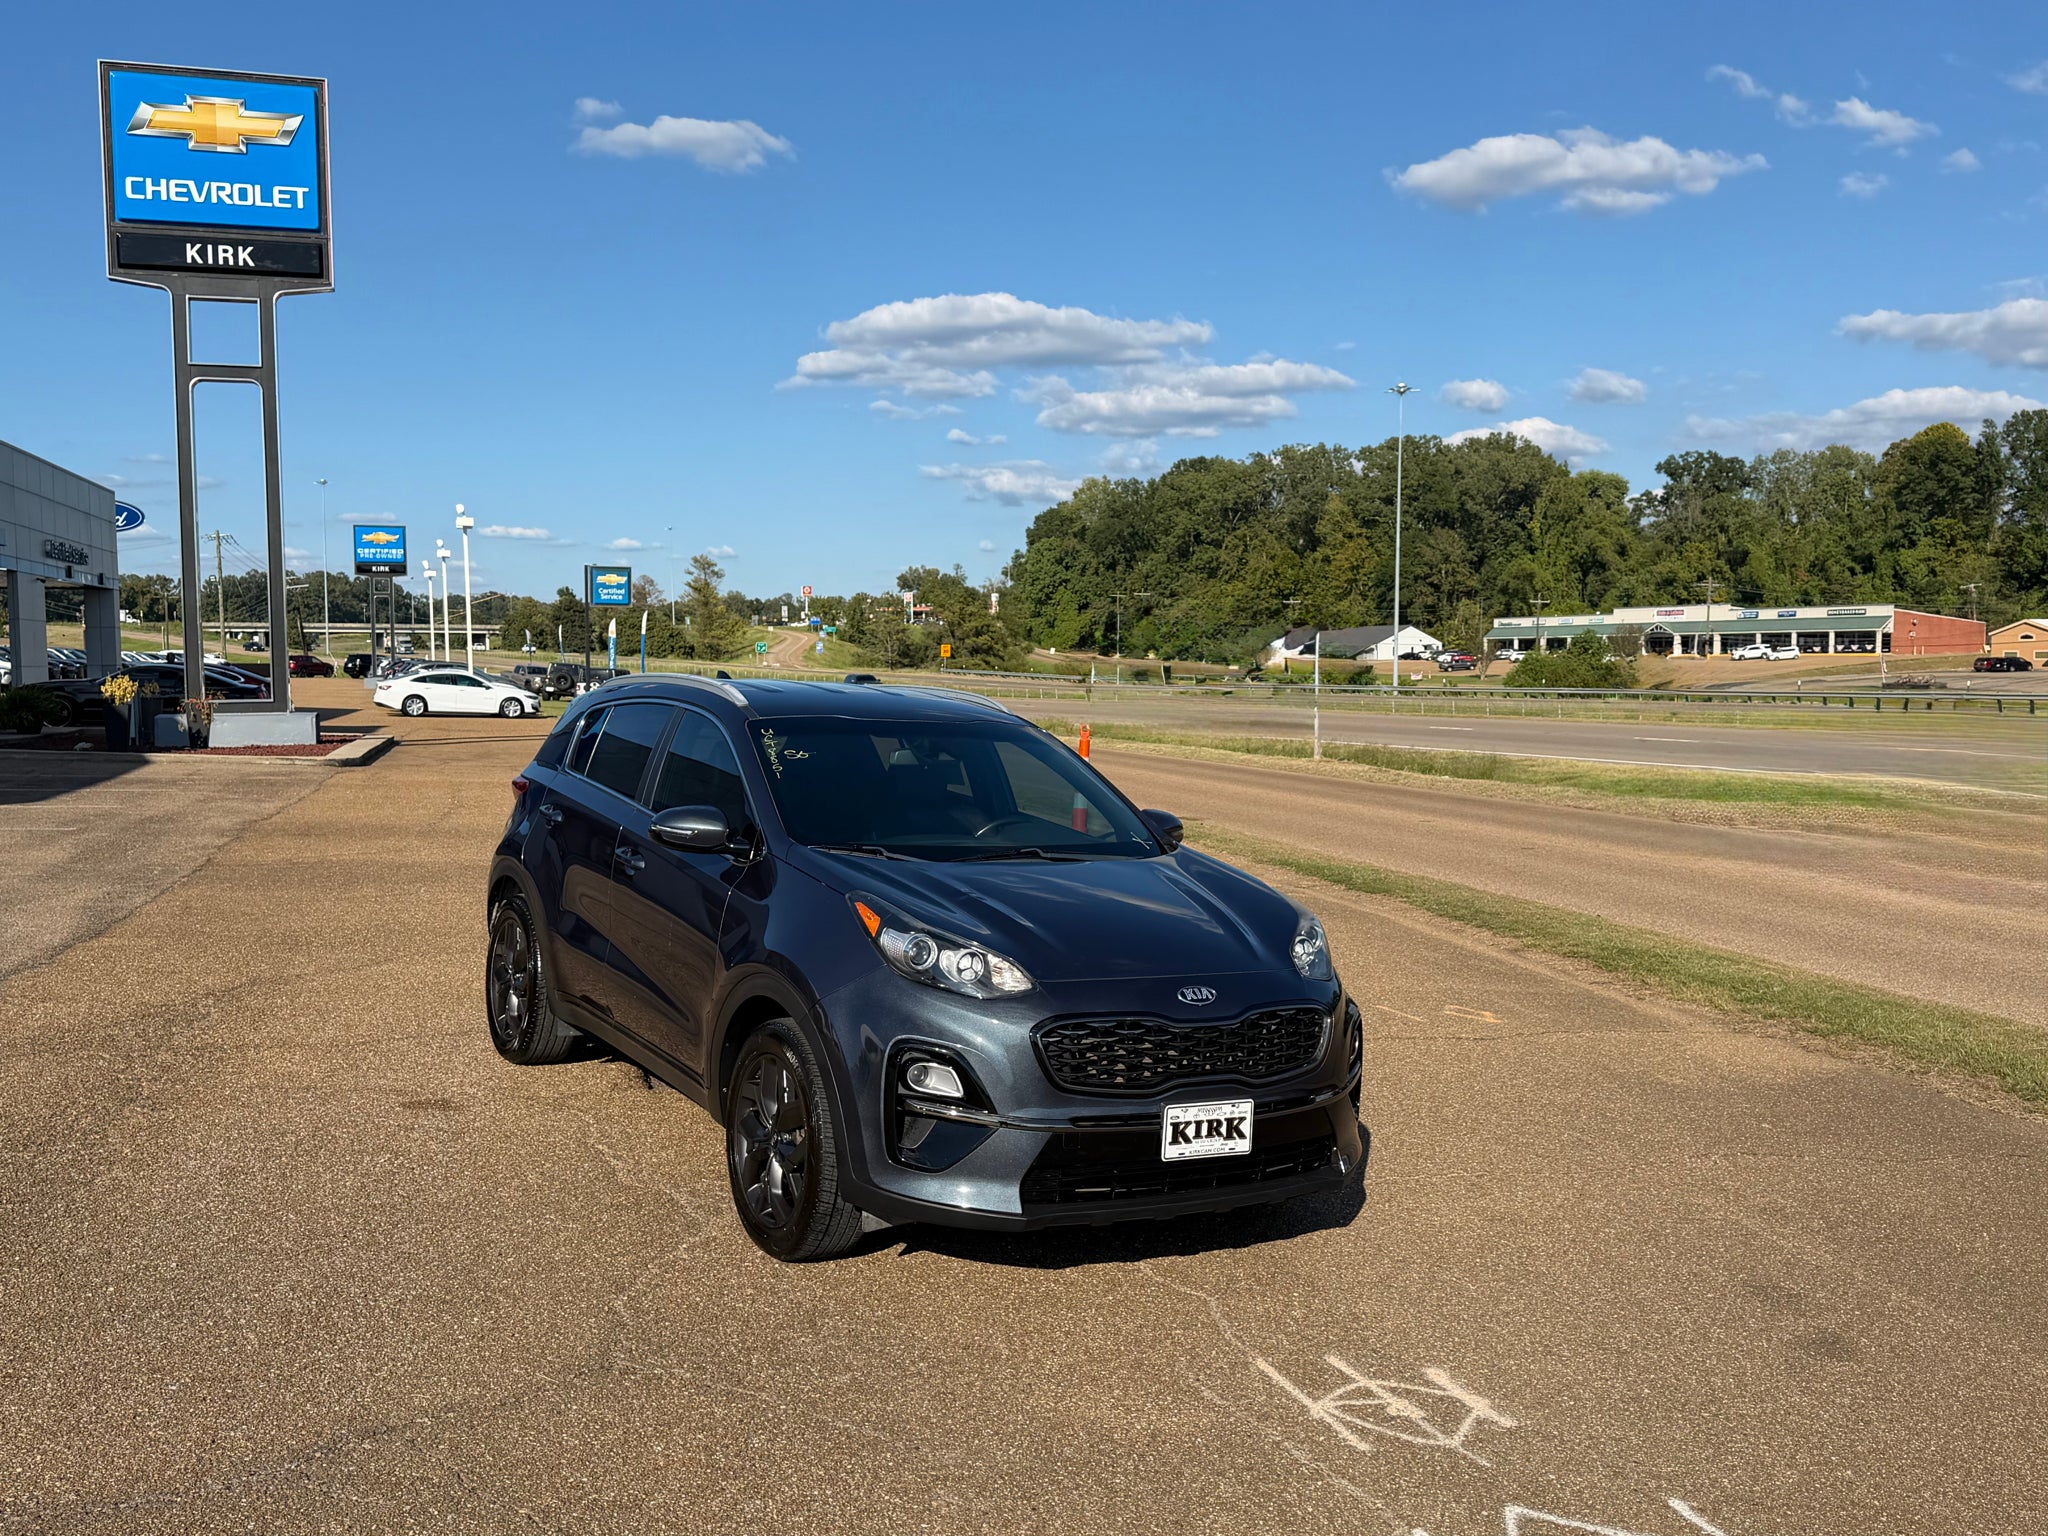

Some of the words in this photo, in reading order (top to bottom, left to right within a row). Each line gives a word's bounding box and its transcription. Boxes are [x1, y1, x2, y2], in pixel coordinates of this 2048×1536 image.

[125, 176, 309, 209] CHEVROLET
[185, 242, 256, 267] KIRK
[1183, 988, 1212, 1000] KIA
[1168, 1116, 1248, 1146] KIRK
